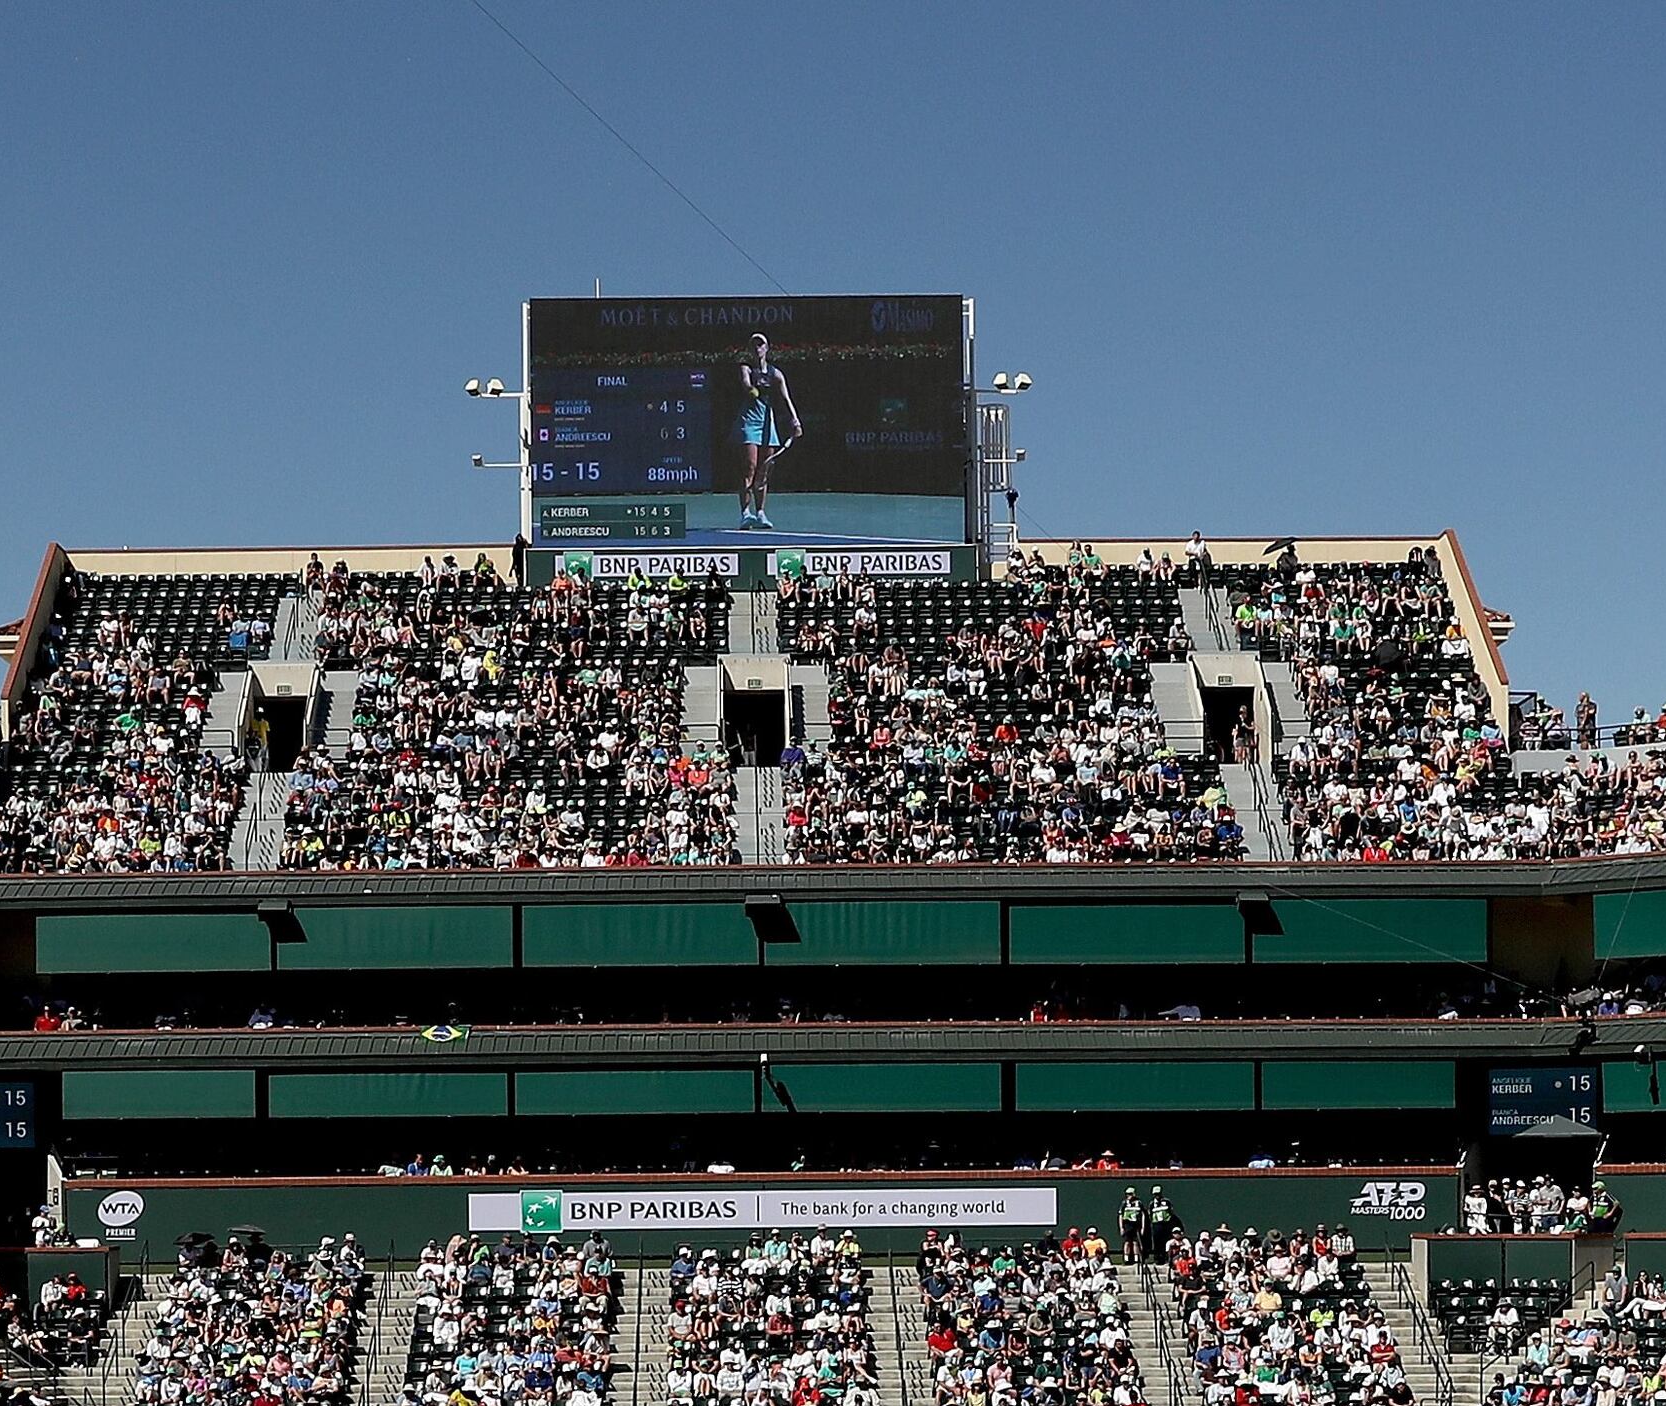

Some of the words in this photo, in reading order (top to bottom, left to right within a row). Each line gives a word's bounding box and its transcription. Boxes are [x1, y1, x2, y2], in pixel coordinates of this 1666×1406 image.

[685, 306, 794, 325] CHANDON
[597, 376, 628, 387] FINAL
[659, 400, 668, 413] 4
[676, 400, 685, 413] 5
[554, 432, 611, 442] ANDREESCU
[660, 428, 669, 440] 6
[676, 427, 685, 439] 3
[532, 462, 554, 481] 15
[575, 462, 601, 481] 15
[647, 466, 698, 484] 88mph
[550, 507, 589, 517] KERBER
[634, 507, 646, 517] 15
[650, 507, 658, 516] 4
[663, 507, 671, 516] 5
[551, 527, 610, 537] ANDREESCU
[634, 527, 646, 536] 15
[663, 527, 671, 536] 3
[600, 557, 640, 574] BNP
[648, 556, 731, 573] PARIBAS
[811, 555, 851, 572] BNP
[861, 554, 942, 570] PARIBAS
[1492, 1084, 1532, 1094] KERBER
[1569, 1075, 1590, 1091] 15
[5, 1090, 26, 1106] 15
[1492, 1115, 1554, 1125] ANDREESCU
[1569, 1107, 1590, 1124] 15
[5, 1122, 27, 1138] 15
[1349, 1182, 1426, 1206] ATP
[97, 1202, 140, 1214] WTA
[570, 1201, 623, 1220] BNP
[629, 1200, 737, 1220] PARIBAS
[781, 1200, 807, 1215] The
[812, 1199, 848, 1215] bank
[851, 1199, 874, 1217] for
[878, 1204, 887, 1215] a
[890, 1199, 959, 1219] changing
[962, 1198, 1005, 1215] world
[1390, 1206, 1426, 1220] 1000
[105, 1228, 136, 1237] PREMIER
